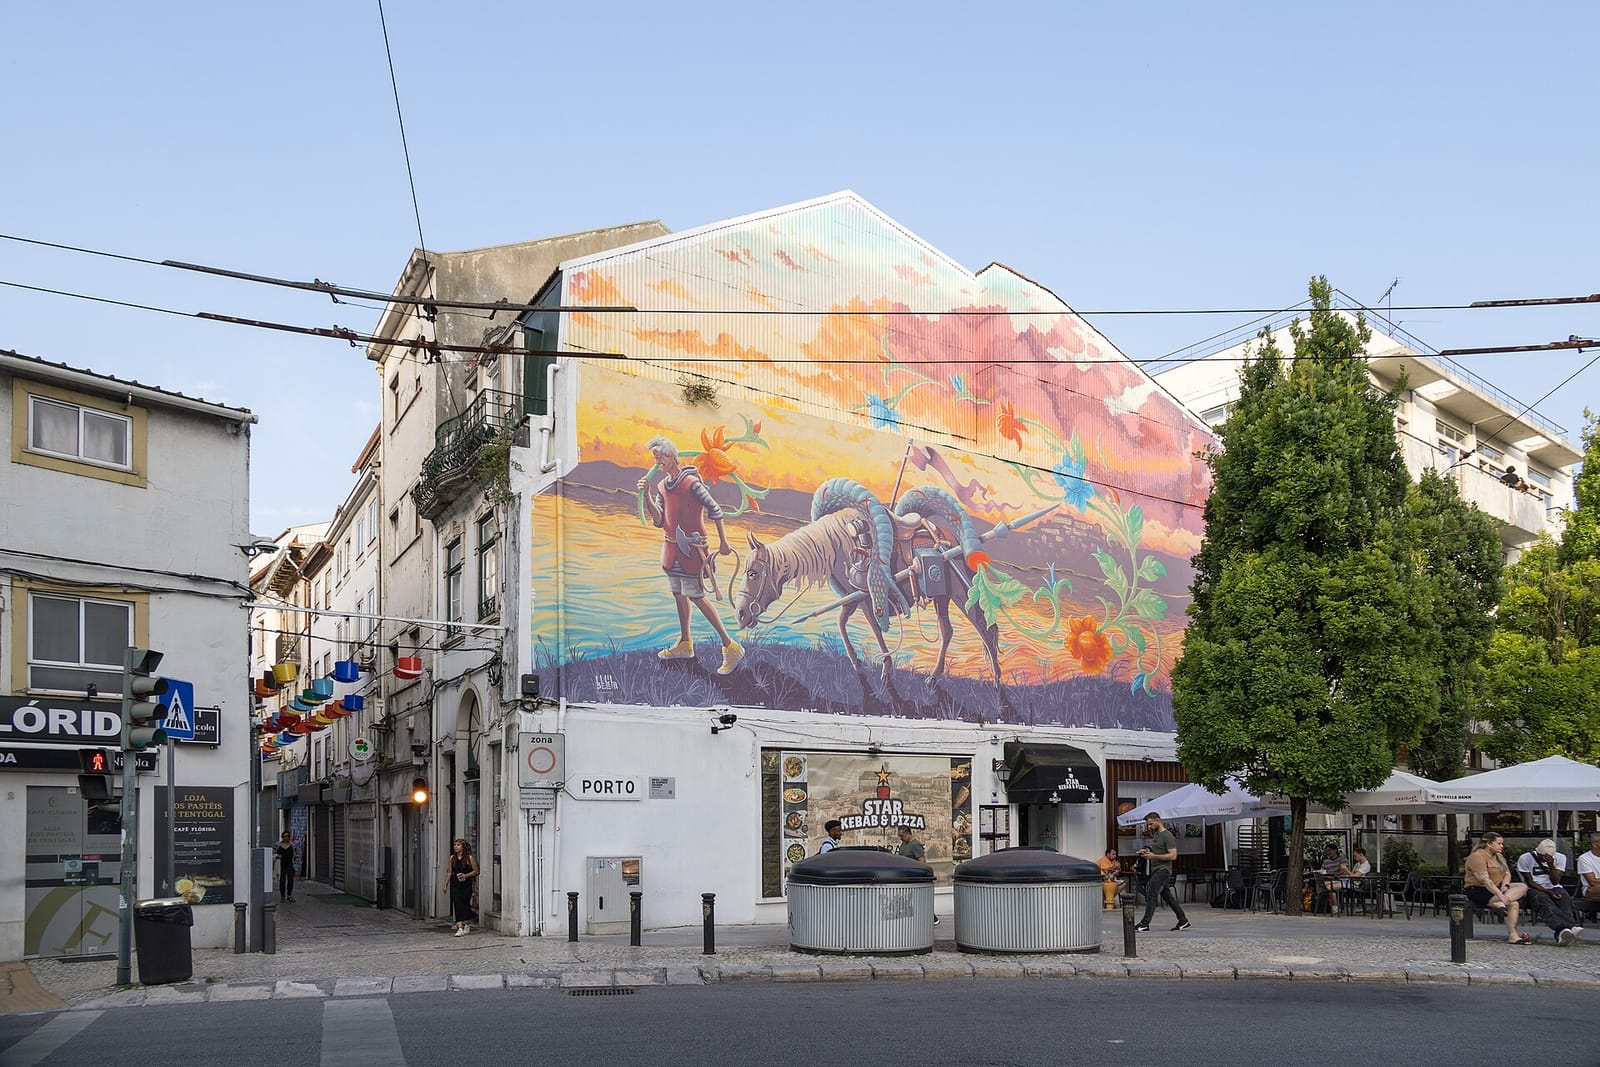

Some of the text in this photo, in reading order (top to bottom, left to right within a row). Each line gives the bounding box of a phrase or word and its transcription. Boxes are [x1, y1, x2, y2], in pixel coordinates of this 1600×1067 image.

[0, 700, 121, 737] ÓRID
[113, 756, 149, 767] Niola
[582, 780, 635, 794] PORTO
[187, 801, 223, 810] PASTÉIS
[864, 800, 903, 816] STAR
[840, 814, 924, 831] KEBAB & PIZZA
